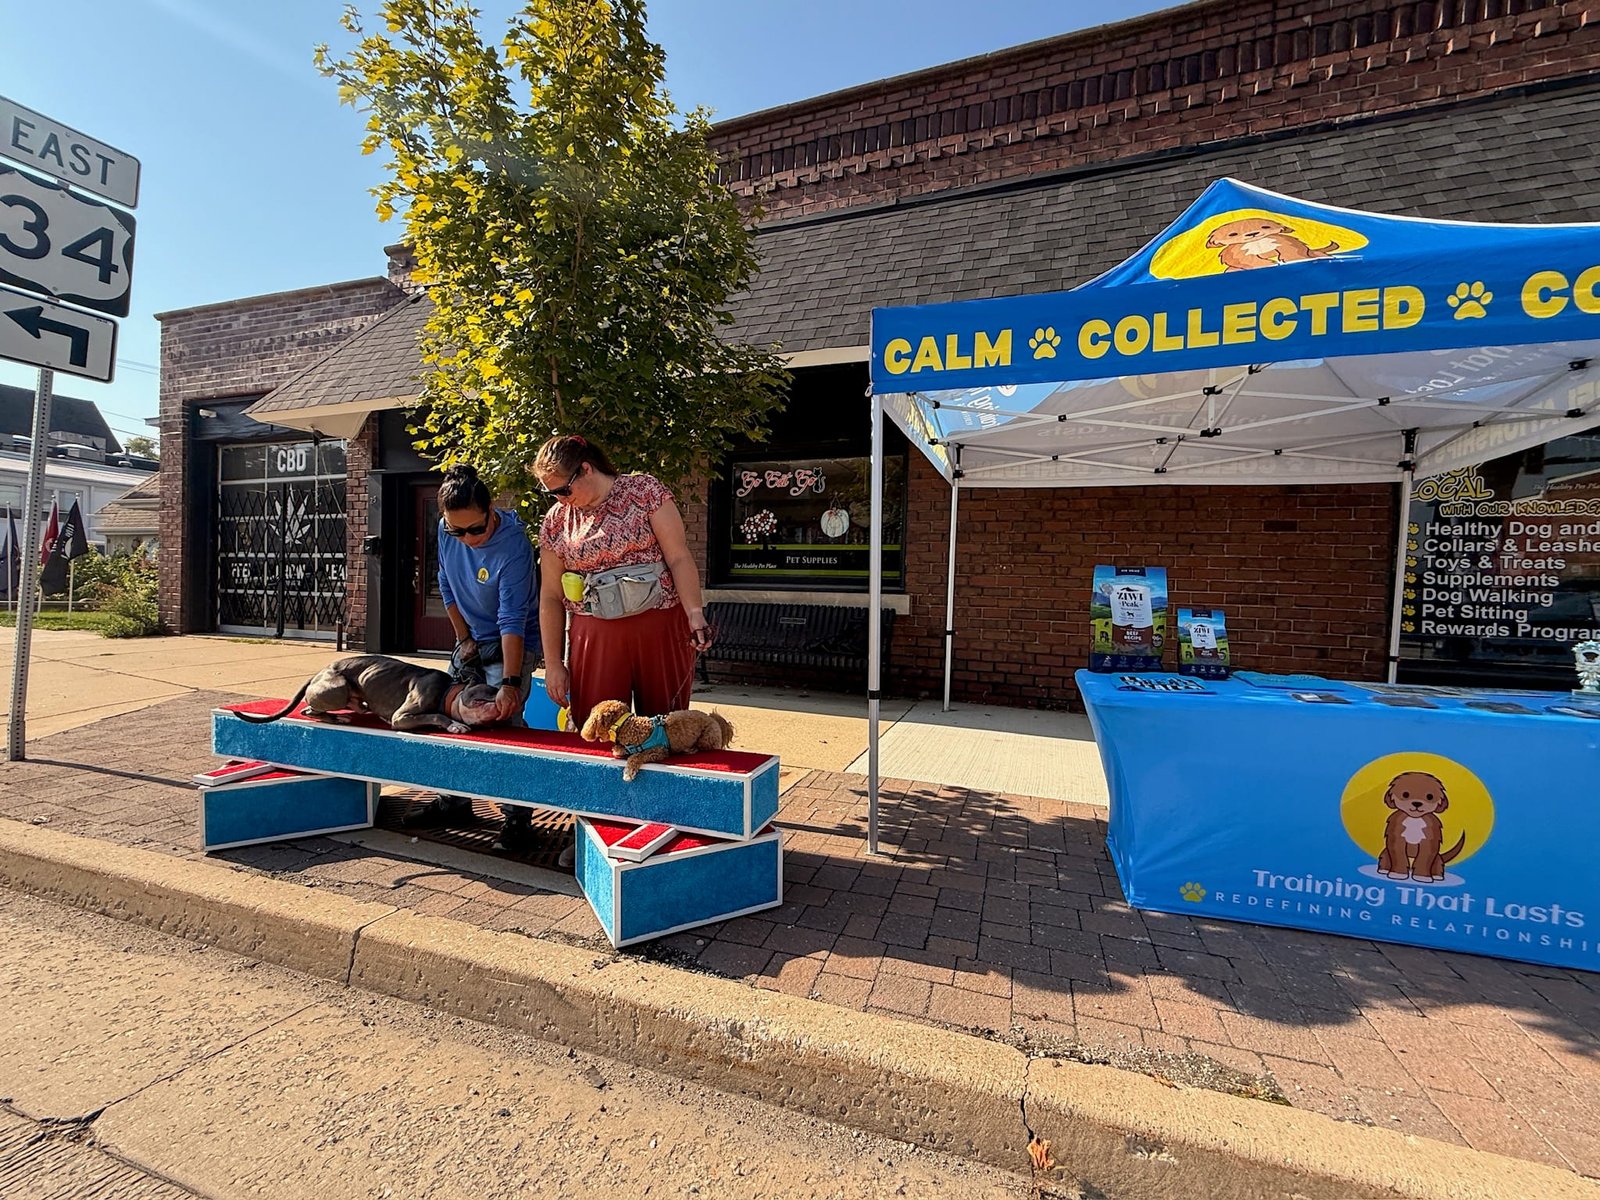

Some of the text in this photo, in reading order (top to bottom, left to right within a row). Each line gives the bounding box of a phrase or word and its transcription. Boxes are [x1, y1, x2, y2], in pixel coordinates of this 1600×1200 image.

[11, 116, 115, 186] EAST
[0, 194, 119, 285] 34
[884, 329, 1013, 375] CALM
[1077, 285, 1426, 359] COLLECTED
[277, 449, 307, 473] CBD
[1411, 476, 1494, 501] OCAL
[1440, 503, 1474, 517] WITH
[1477, 502, 1511, 516] OUR
[1425, 521, 1600, 538] Healthy Dog and
[1424, 539, 1496, 552] Collars
[1503, 538, 1518, 552] &
[786, 556, 838, 564] PET SUPPLIES
[1423, 555, 1566, 571] Toys & Treats
[1422, 572, 1560, 588] Supplements
[1117, 592, 1143, 601] ZIWI
[1422, 588, 1553, 606] Dog Walking
[1421, 604, 1528, 623] Pet Sitting
[1421, 620, 1510, 636] Rewards
[1252, 869, 1585, 928] Training That Lasts
[1215, 891, 1600, 953] REDEFINING RELATIONSHI
